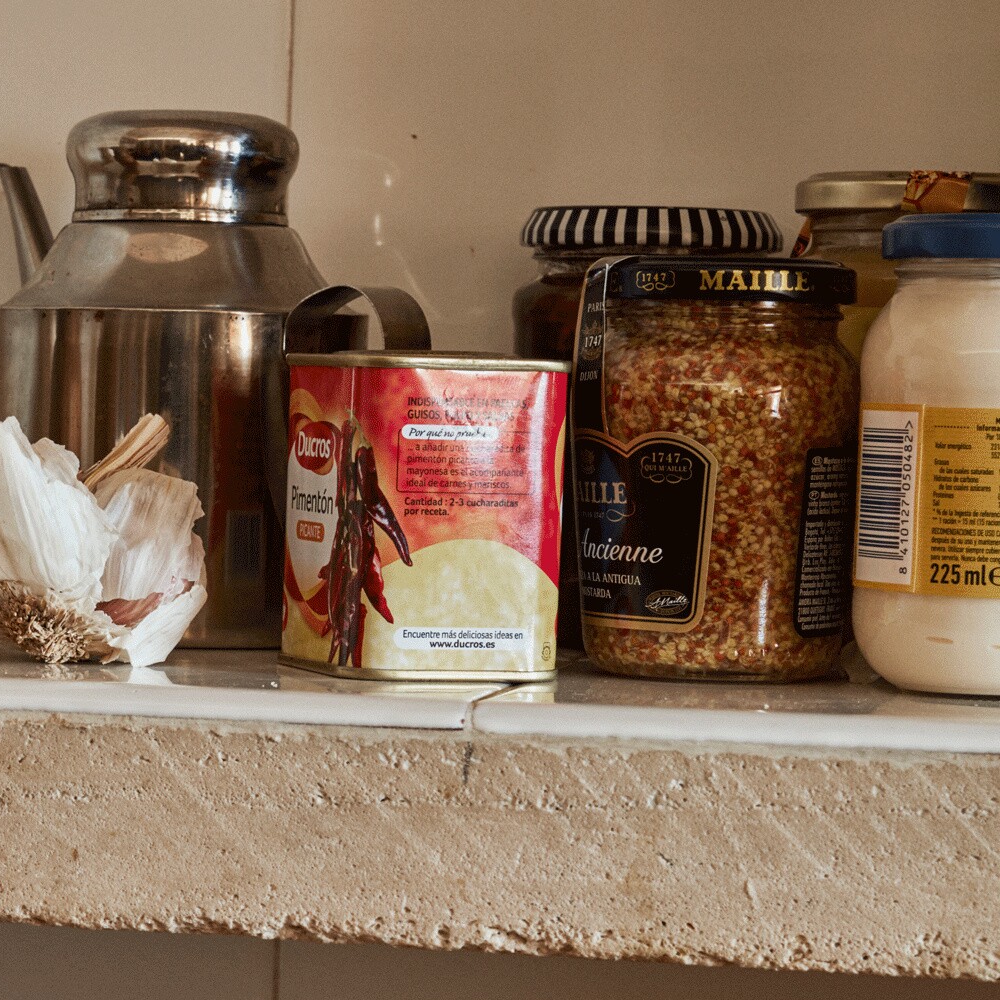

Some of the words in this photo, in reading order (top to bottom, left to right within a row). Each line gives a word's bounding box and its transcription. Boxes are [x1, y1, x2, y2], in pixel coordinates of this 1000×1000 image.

[642, 273, 667, 282] 1747
[700, 269, 810, 291] MAILLE
[585, 335, 602, 348] 1747
[407, 409, 443, 421] GUISOS,
[409, 427, 425, 437] Por
[427, 429, 443, 440] qué
[298, 431, 331, 459] Ducros
[406, 455, 447, 465] pimentón
[651, 452, 681, 463] 1747
[901, 434, 914, 491] 050482
[406, 467, 448, 478] mayonesa
[406, 479, 426, 487] ideal
[440, 480, 467, 488] carnes
[291, 484, 334, 515] Pimentón
[404, 496, 443, 506] Cantidad
[449, 497, 465, 507] 2-3
[466, 499, 519, 508] cucharaditas
[404, 508, 419, 517] por
[420, 507, 450, 516] receta.
[299, 523, 322, 539] PICANTE
[899, 499, 911, 556] 410127
[602, 573, 642, 585] ANTIGUA
[930, 562, 962, 585] 225
[963, 564, 987, 586] ml
[402, 629, 441, 639] Encuentre
[441, 630, 457, 639] más
[458, 630, 493, 639] deliciosas
[494, 630, 514, 639] ideas
[429, 639, 496, 649] www.ducros.es
